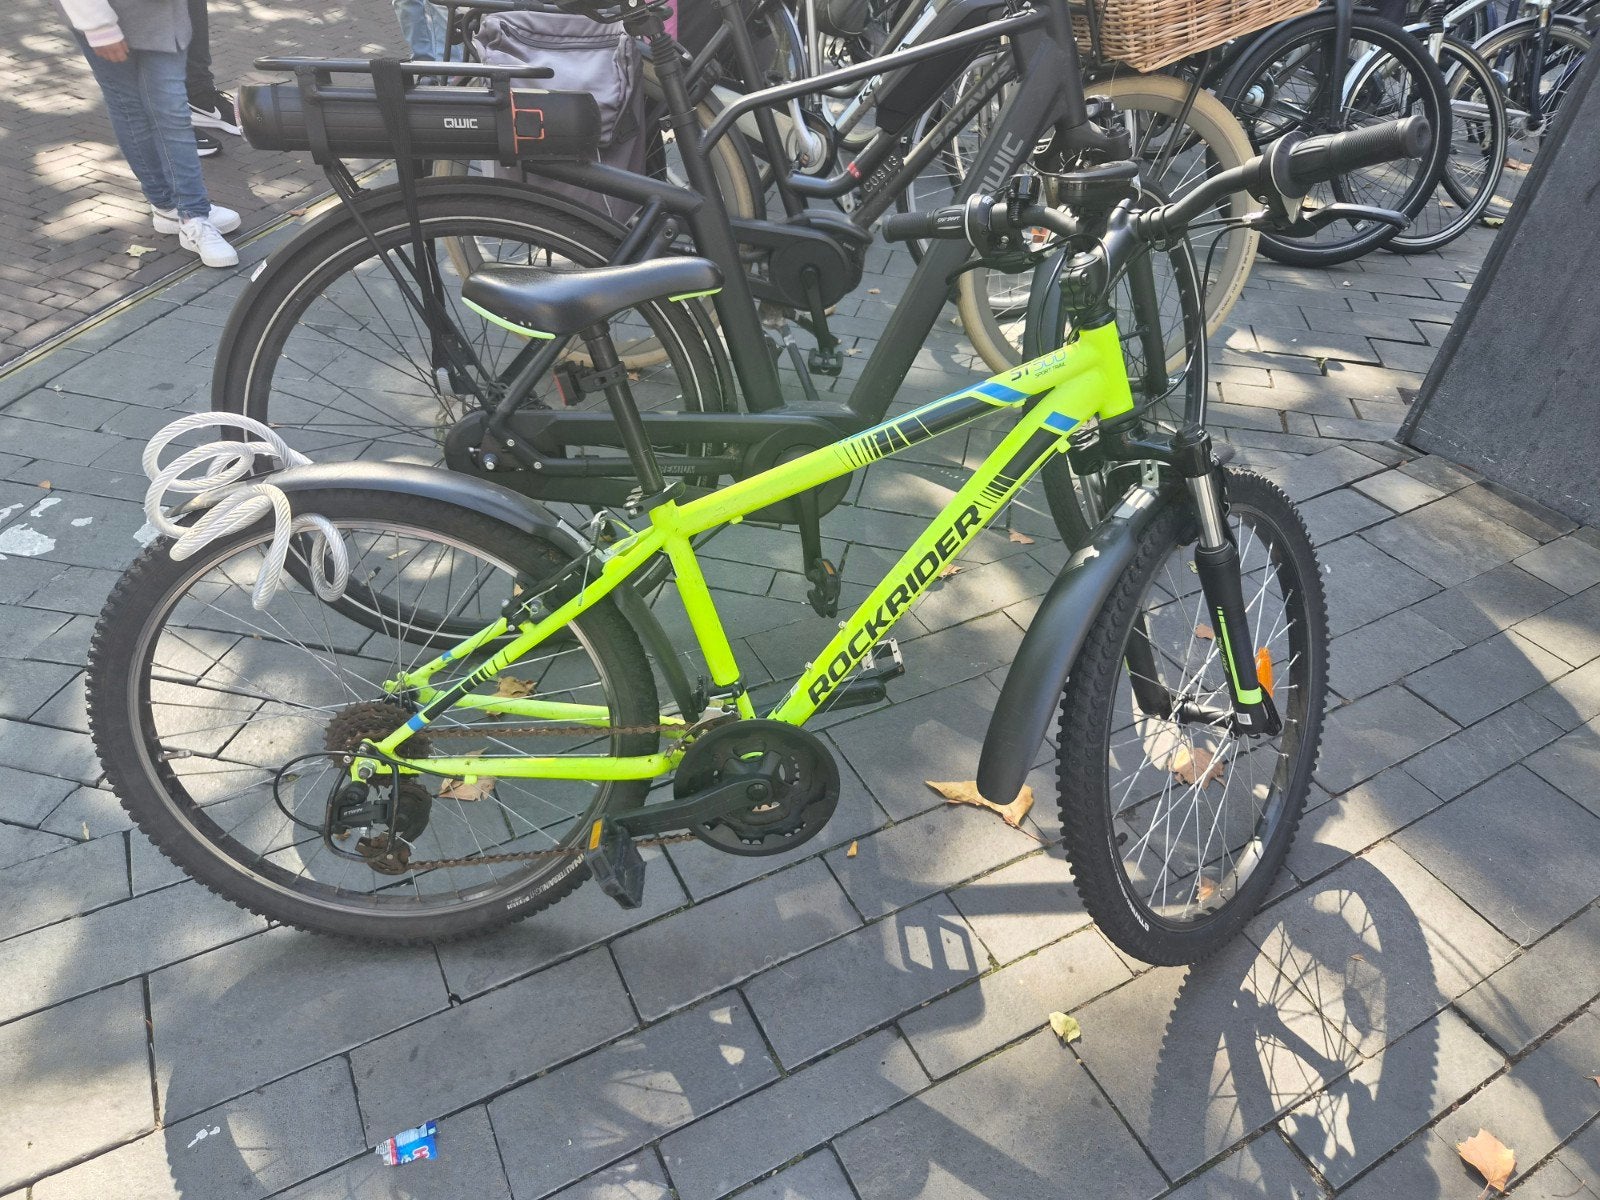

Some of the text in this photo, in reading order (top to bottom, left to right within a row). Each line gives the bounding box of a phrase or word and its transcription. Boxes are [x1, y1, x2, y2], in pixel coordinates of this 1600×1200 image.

[443, 117, 478, 129] QWIC
[930, 61, 1011, 150] BATAVUS
[808, 504, 983, 706] ROCKRIDER
